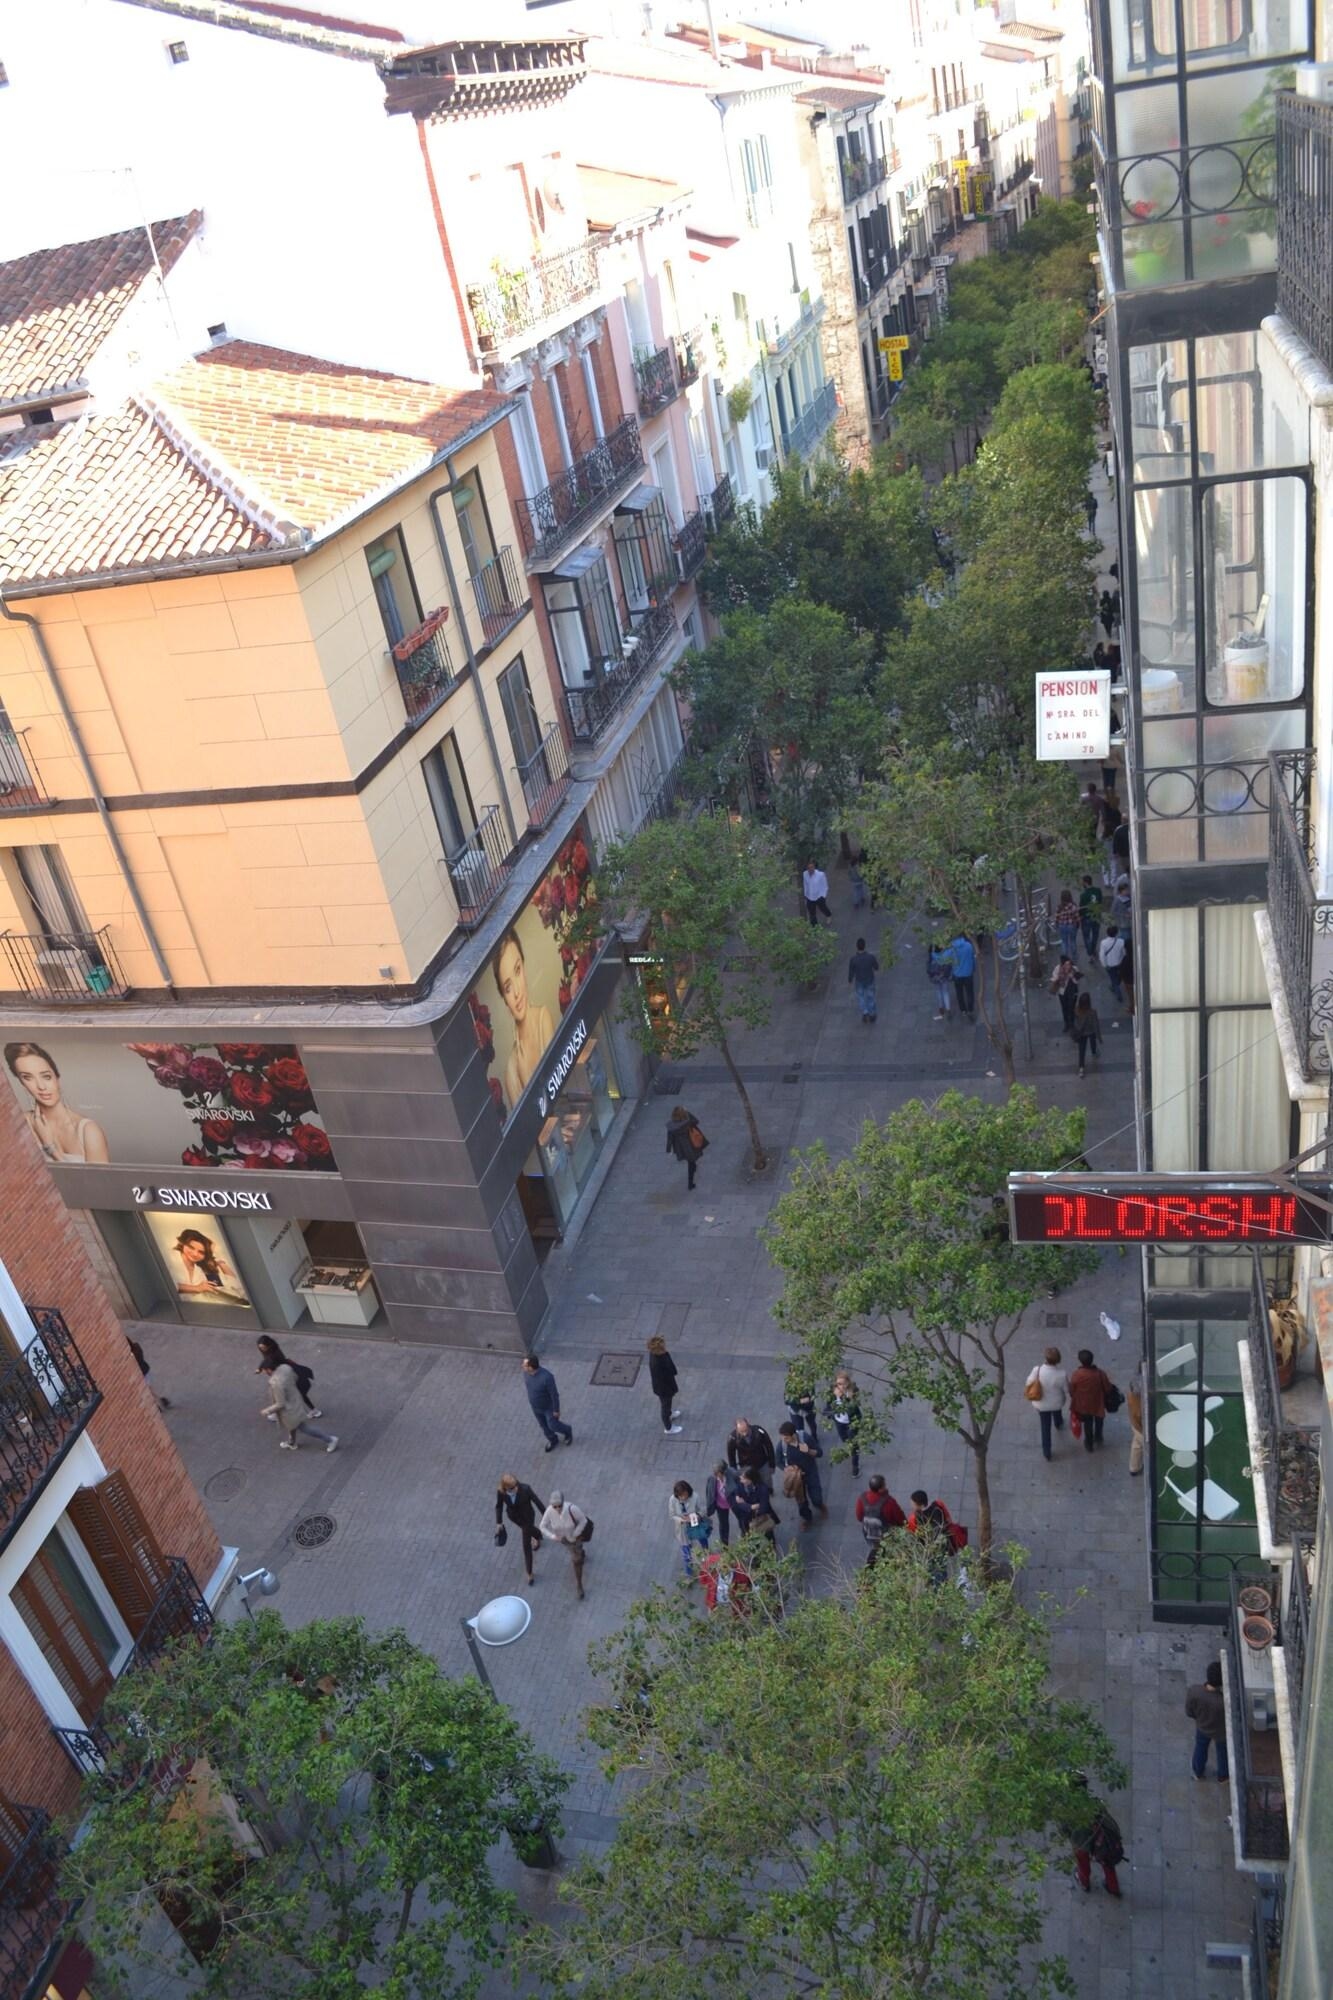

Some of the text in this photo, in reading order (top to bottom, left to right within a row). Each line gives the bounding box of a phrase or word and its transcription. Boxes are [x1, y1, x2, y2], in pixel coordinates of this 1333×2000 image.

[879, 338, 907, 350] HOSTAL
[1041, 680, 1098, 697] PENSION
[1083, 709, 1101, 717] DEL
[1047, 731, 1087, 741] CAMINO
[547, 1019, 588, 1100] SWAROVSKI
[185, 1107, 256, 1122] SWAROVSKI
[157, 1187, 273, 1210] SWAROVSKI
